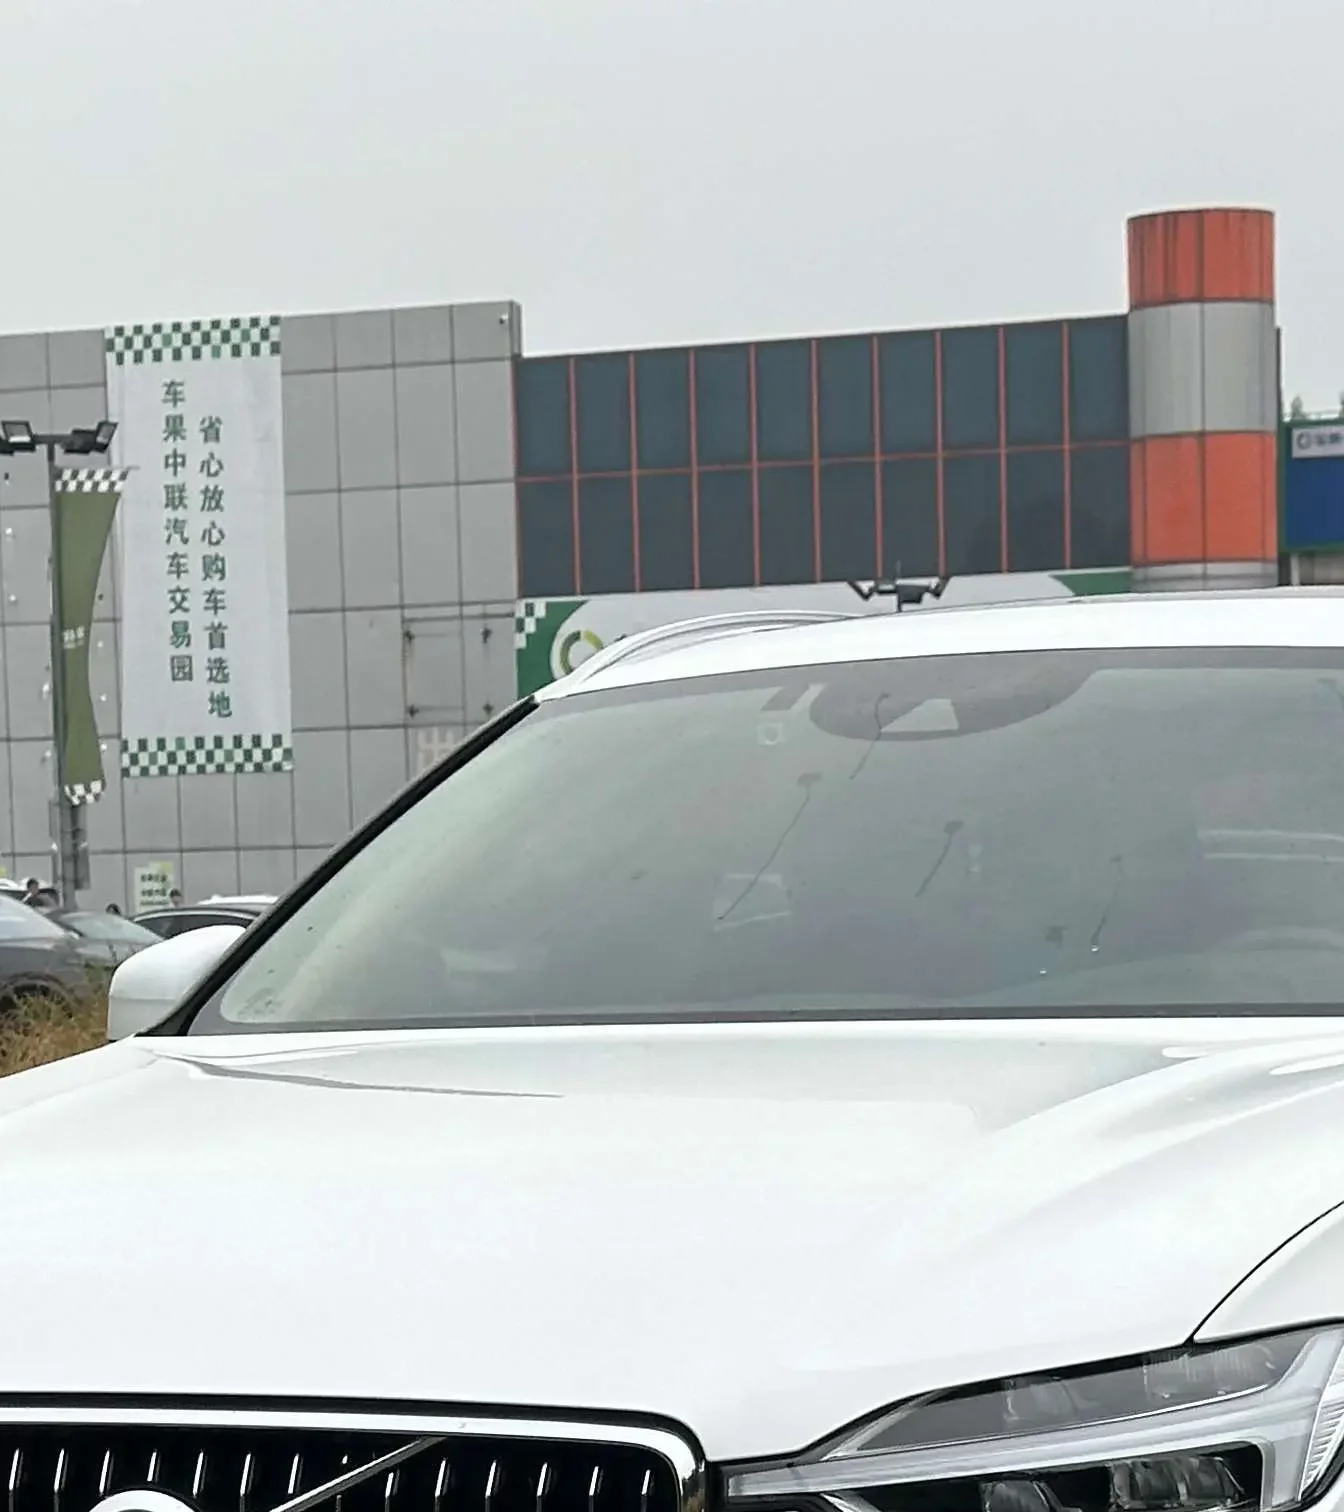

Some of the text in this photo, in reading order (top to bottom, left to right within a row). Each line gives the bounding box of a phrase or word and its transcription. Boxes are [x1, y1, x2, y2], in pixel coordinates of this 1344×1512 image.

[162, 379, 194, 682] 车果中联汽车交易园
[199, 415, 233, 719] 省心放心购车首选地
